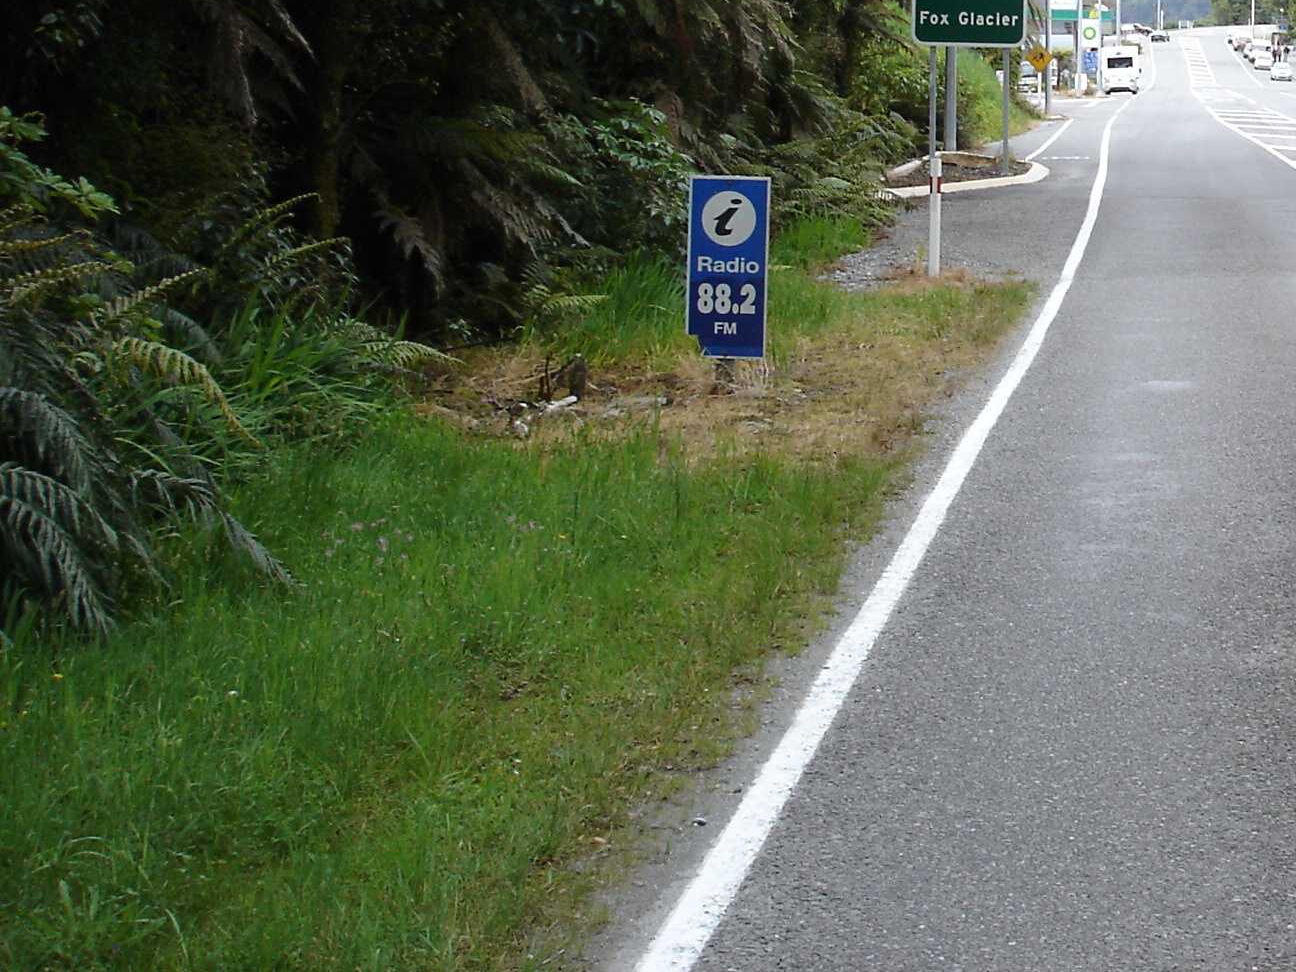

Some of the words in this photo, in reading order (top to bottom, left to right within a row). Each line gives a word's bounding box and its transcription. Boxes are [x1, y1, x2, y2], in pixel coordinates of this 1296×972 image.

[919, 10, 949, 25] Fox
[958, 11, 1019, 26] Glacier
[697, 256, 760, 274] Radio
[697, 282, 757, 315] 88.2
[713, 322, 737, 335] FM
